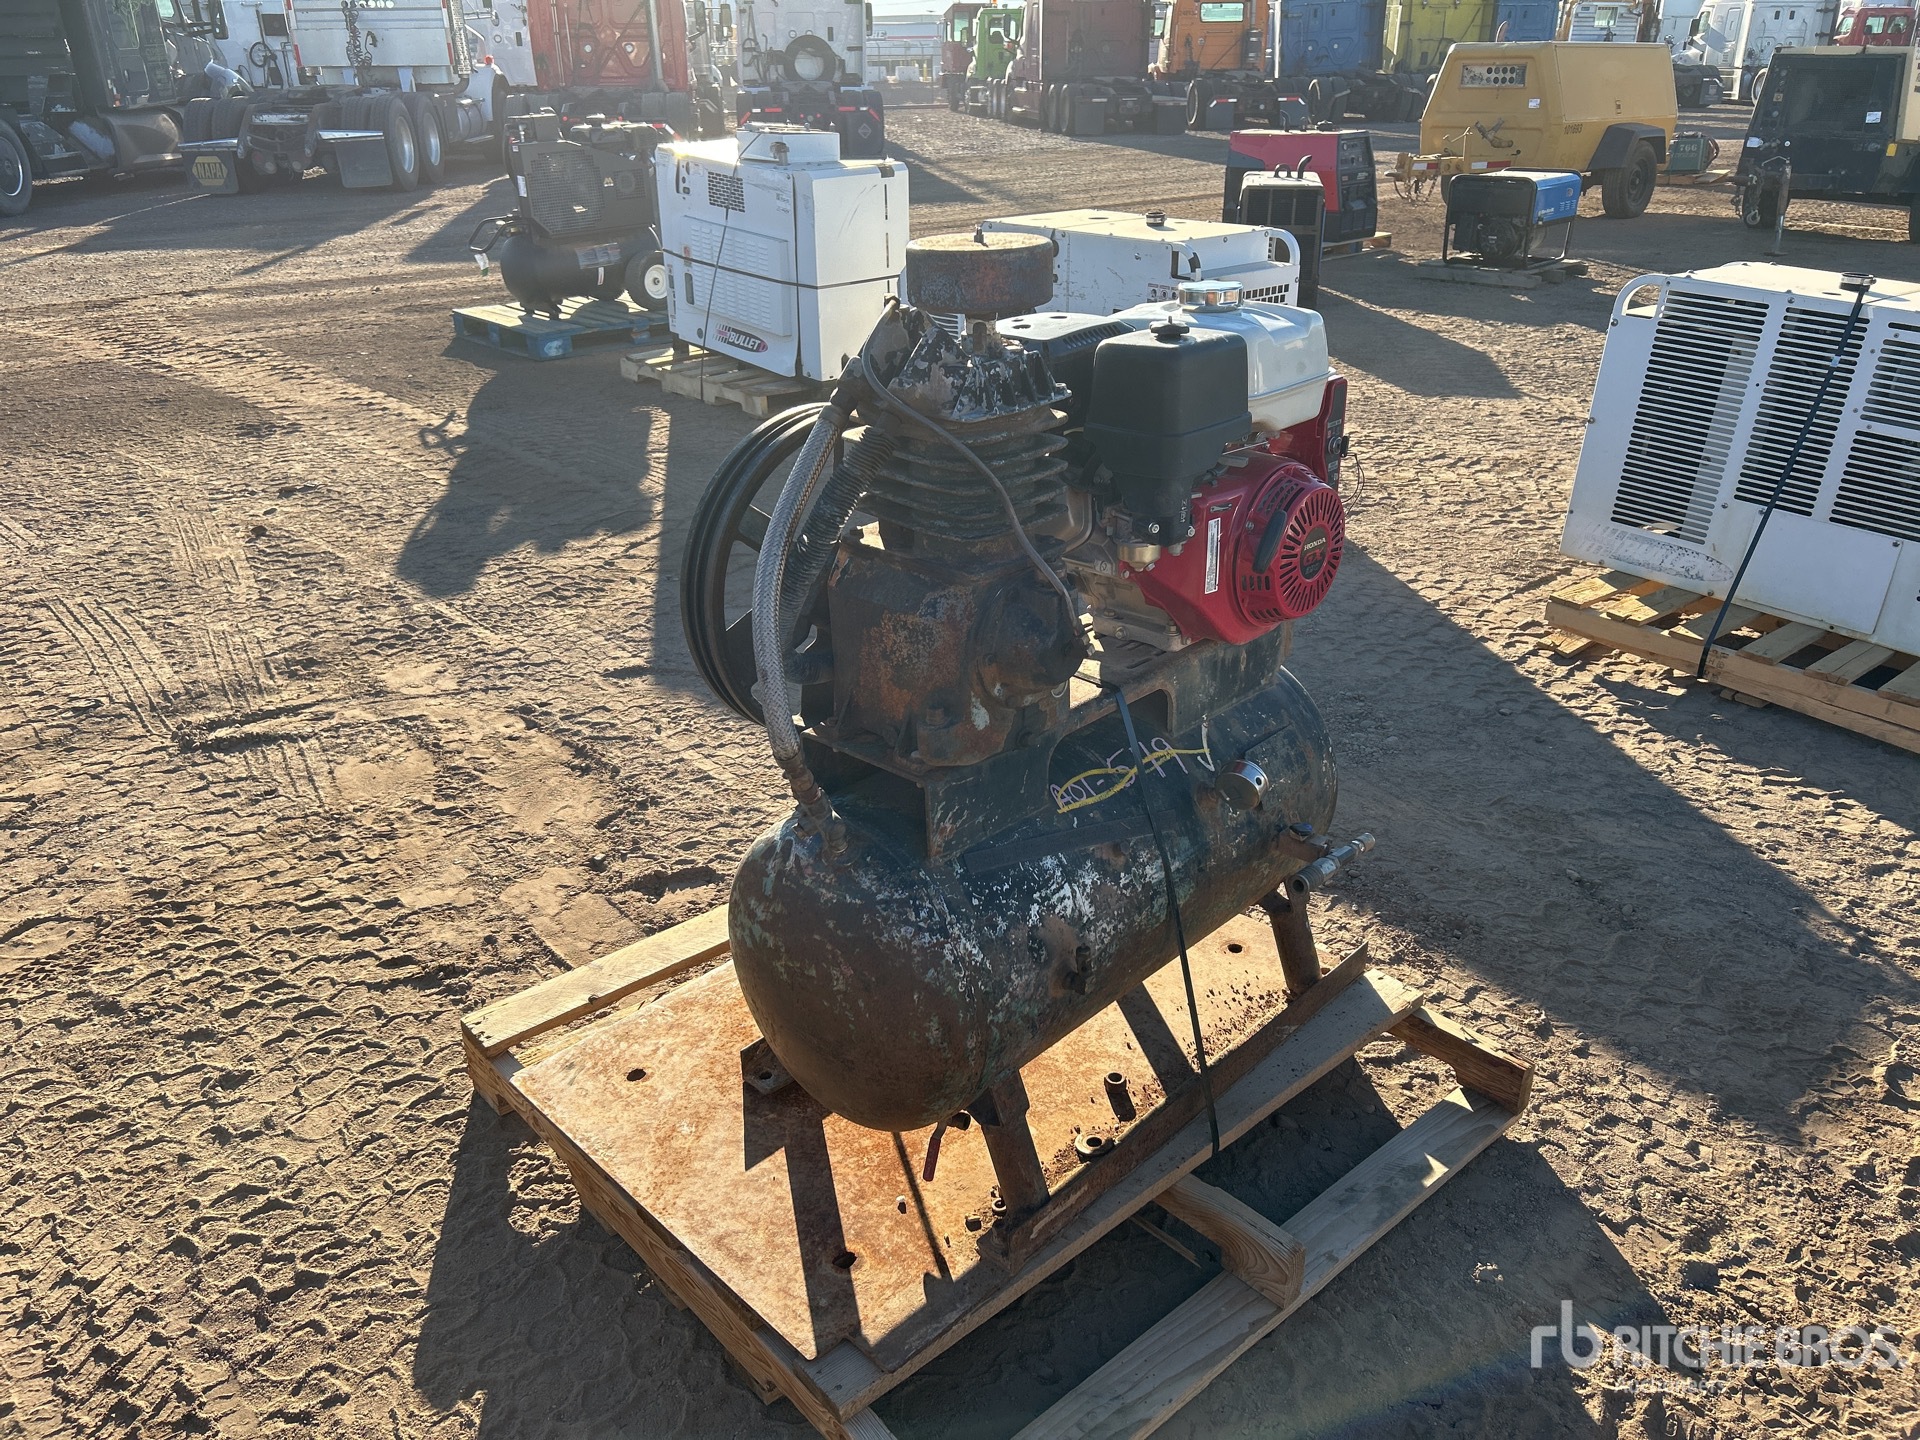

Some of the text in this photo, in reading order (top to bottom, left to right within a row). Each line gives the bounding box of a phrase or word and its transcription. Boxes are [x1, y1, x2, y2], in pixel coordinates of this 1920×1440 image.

[1680, 143, 1698, 152] 766
[196, 162, 224, 179] NAPA
[728, 331, 761, 351] BULLET
[1303, 537, 1326, 551] HONDA
